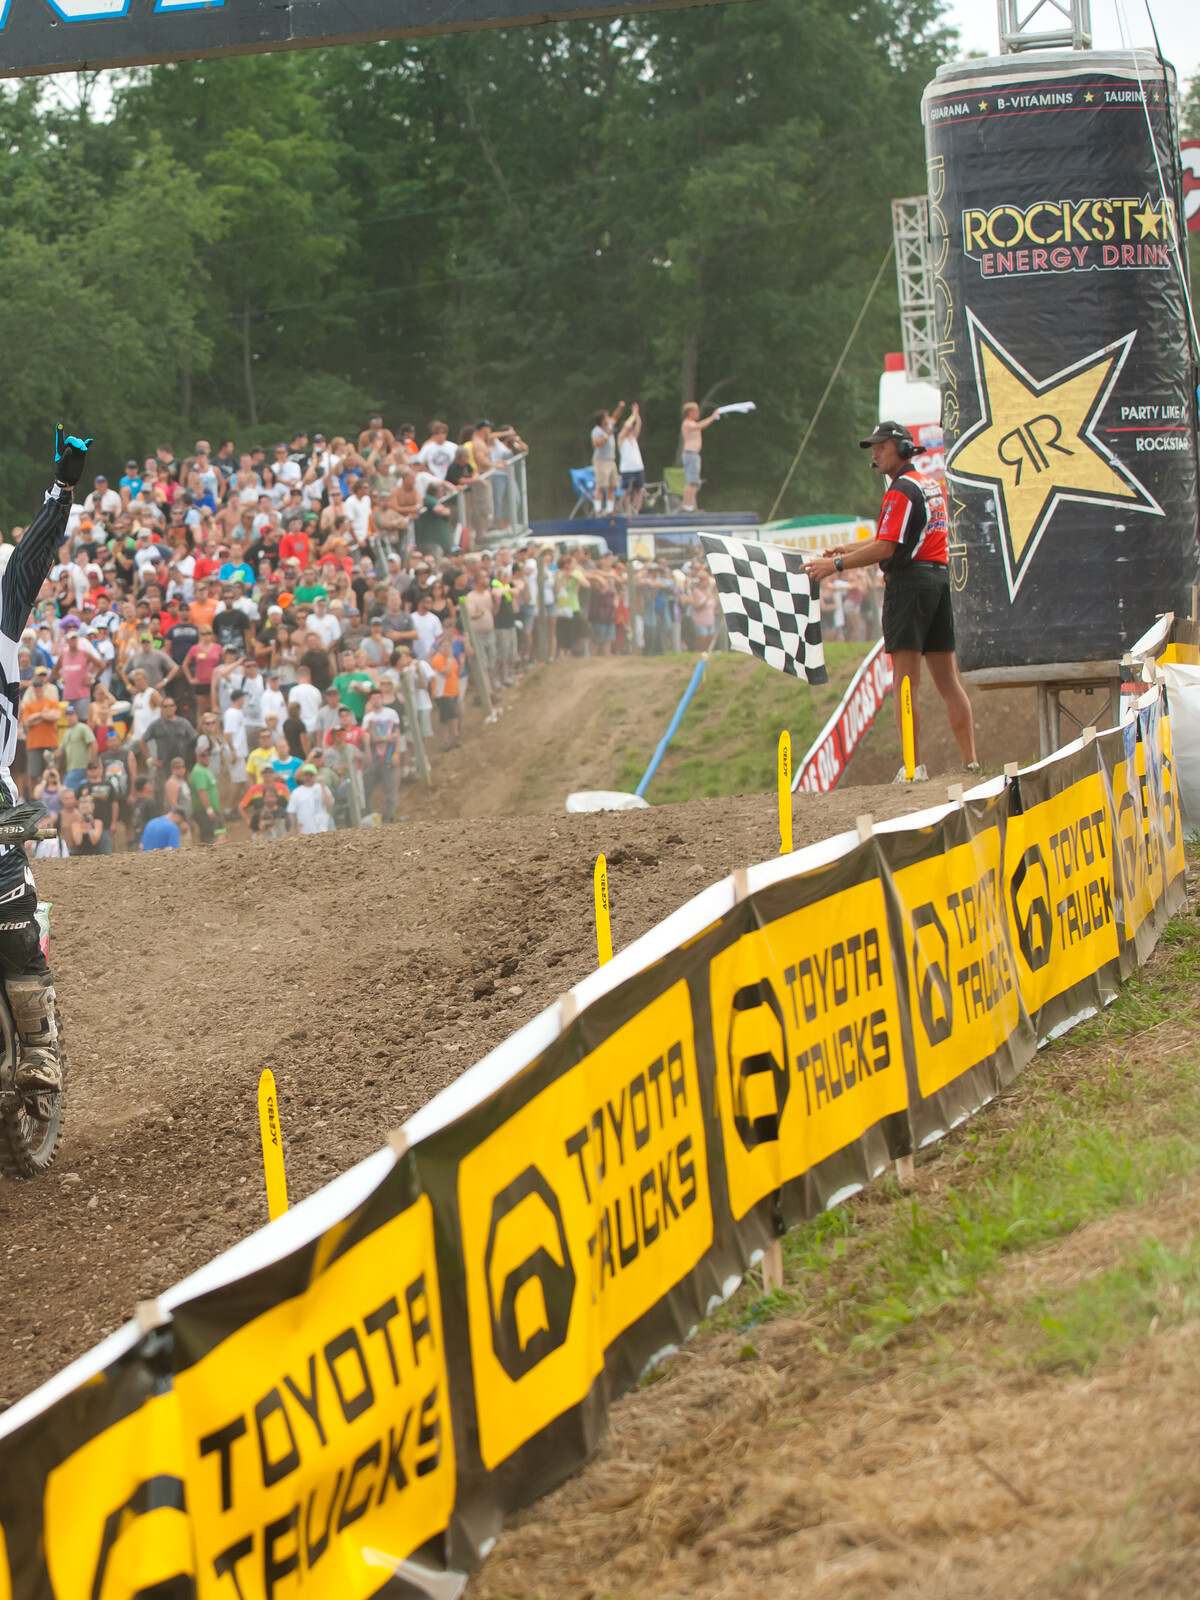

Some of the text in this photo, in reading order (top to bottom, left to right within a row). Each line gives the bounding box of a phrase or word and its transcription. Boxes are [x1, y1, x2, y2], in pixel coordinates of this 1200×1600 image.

[930, 91, 1148, 121] GUARANA B-VITAMINS TAURINE
[983, 244, 1169, 274] ENERGY DRINK
[1121, 405, 1158, 420] PARTY
[1161, 404, 1180, 419] LIKE
[1136, 437, 1188, 451] ROCKSTAR
[843, 671, 876, 754] LUCAS
[817, 735, 840, 792] OIL
[1049, 806, 1107, 884] TOYOT
[784, 927, 883, 1030] TOYOTA
[796, 1008, 890, 1116] TRUCKS
[267, 1096, 278, 1147] ACERBIS
[565, 1040, 688, 1205] TOYOTA
[587, 1133, 697, 1304] TRUCKS
[199, 1270, 437, 1514] TOYOTA
